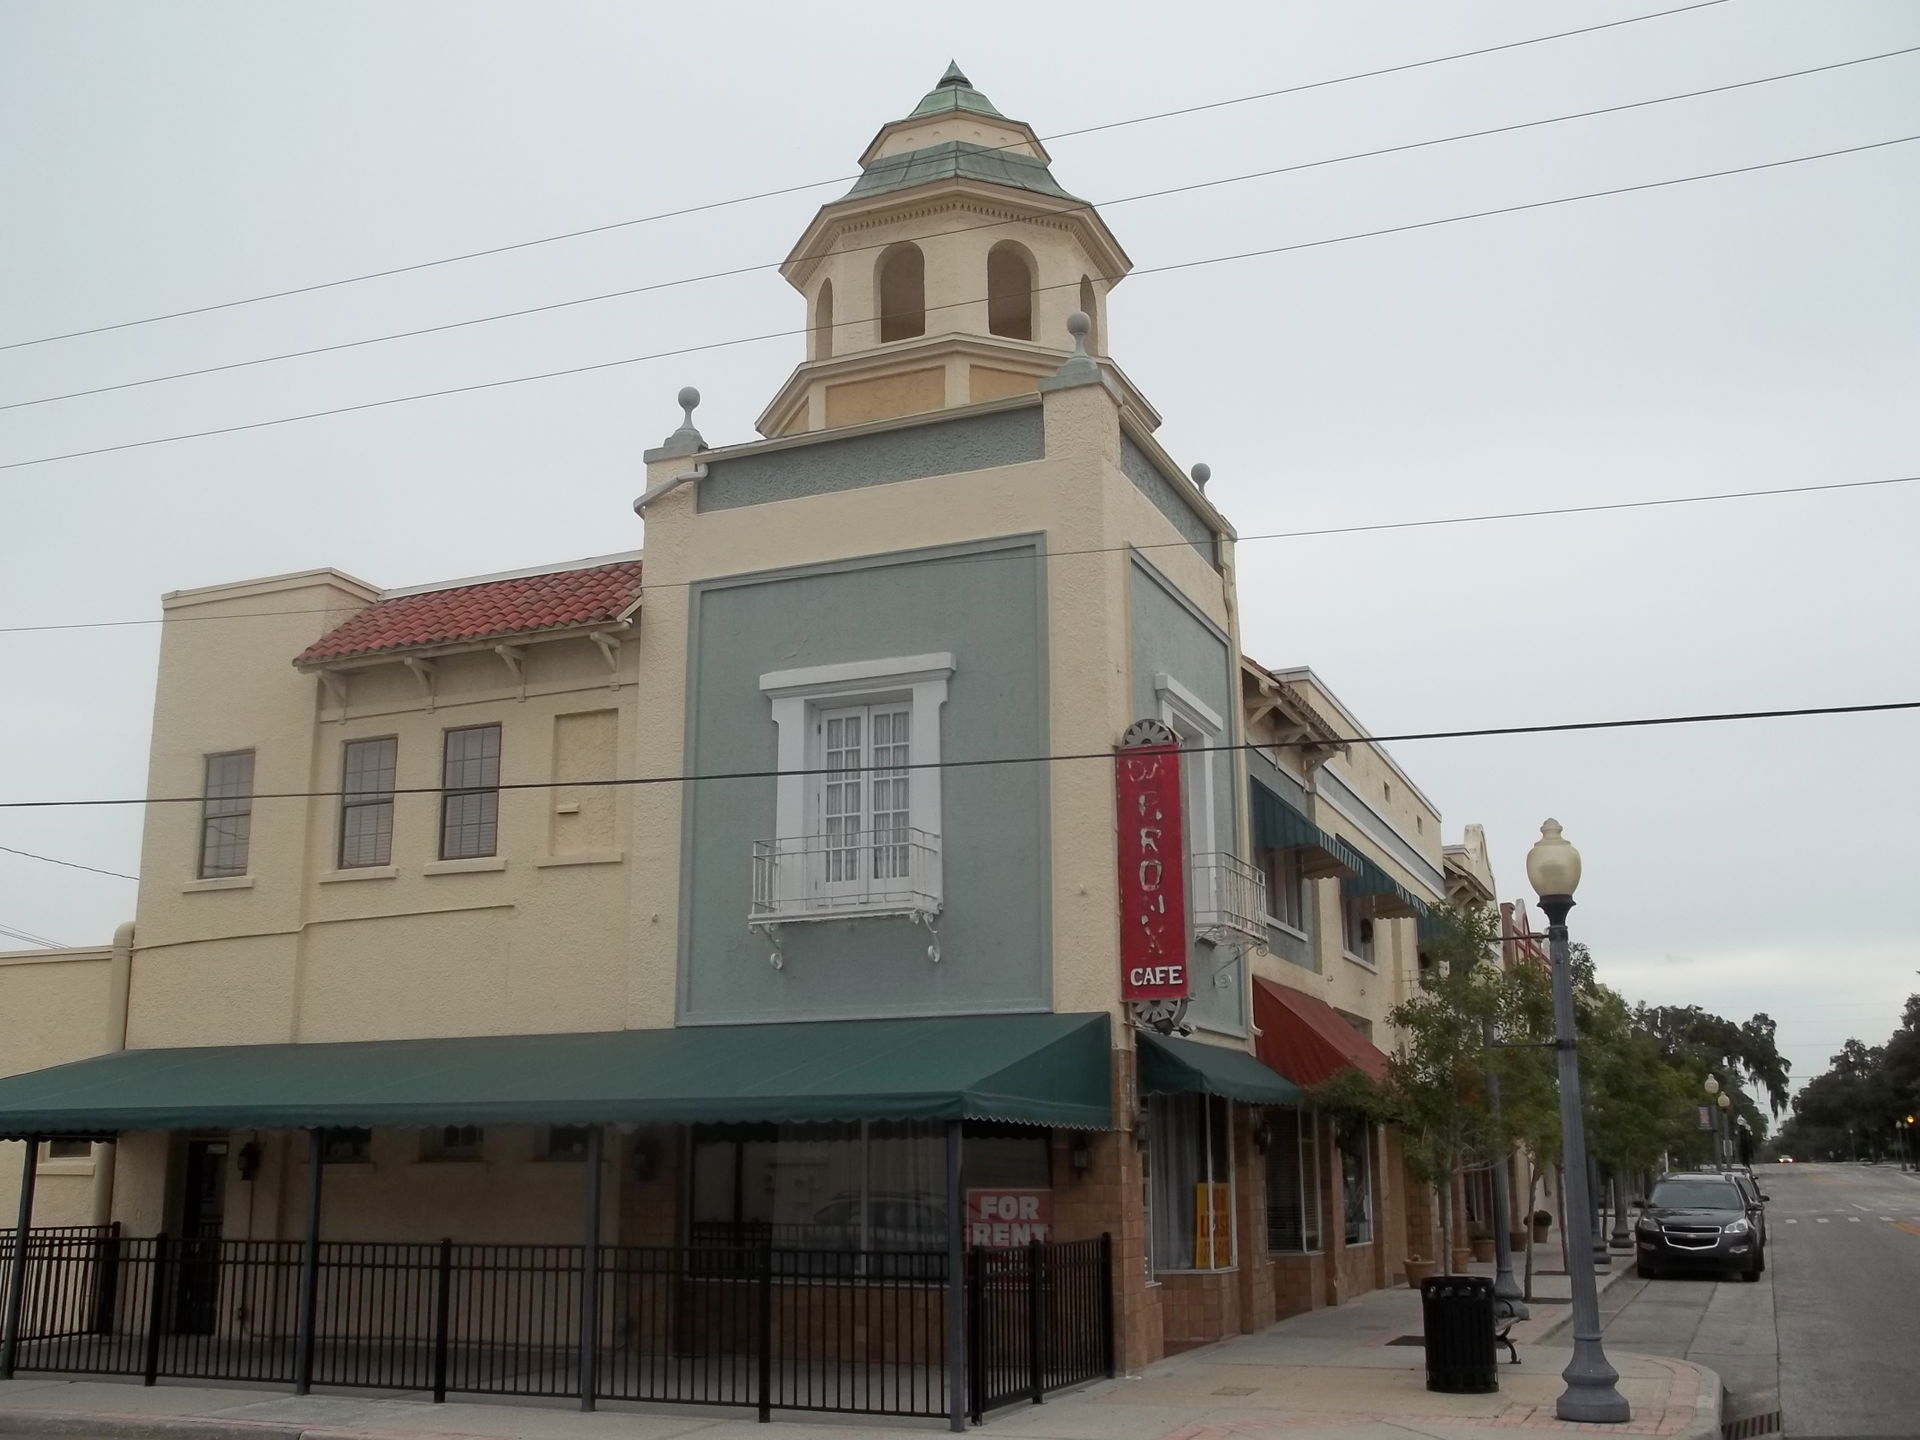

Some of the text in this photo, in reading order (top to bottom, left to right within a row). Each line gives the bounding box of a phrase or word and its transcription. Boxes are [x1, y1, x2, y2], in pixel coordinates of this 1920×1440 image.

[1130, 965, 1183, 986] CAFE
[980, 1196, 1040, 1220] FOR
[972, 1222, 1049, 1247] RENT
